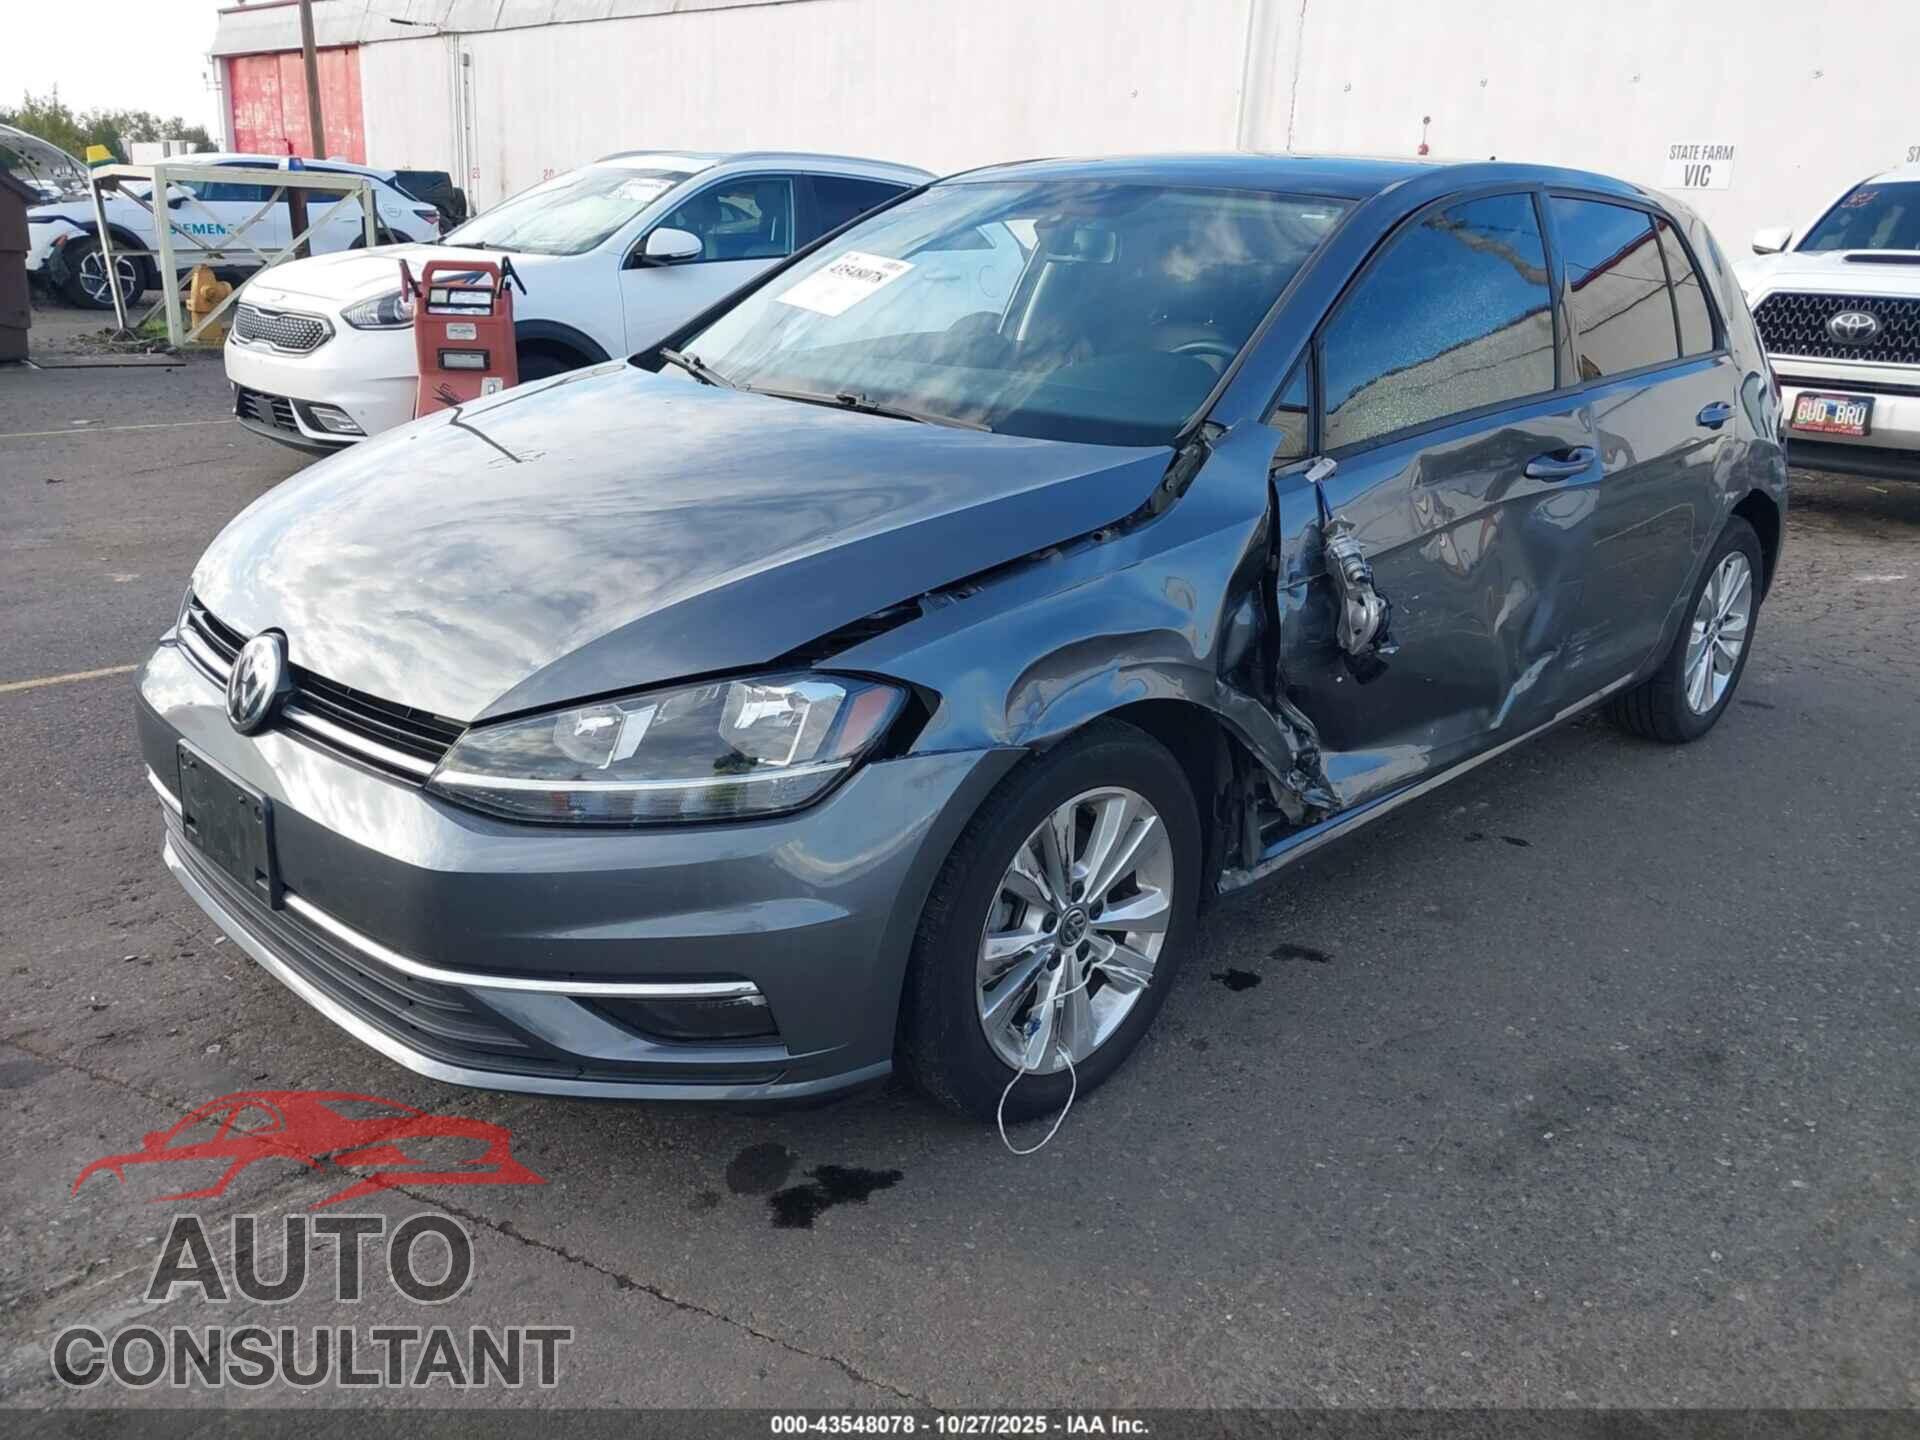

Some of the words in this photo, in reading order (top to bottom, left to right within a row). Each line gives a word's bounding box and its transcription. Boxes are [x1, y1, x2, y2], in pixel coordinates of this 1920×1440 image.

[1669, 144, 1700, 160] STATE
[1702, 144, 1734, 160] FARM
[1684, 164, 1711, 186] VIC
